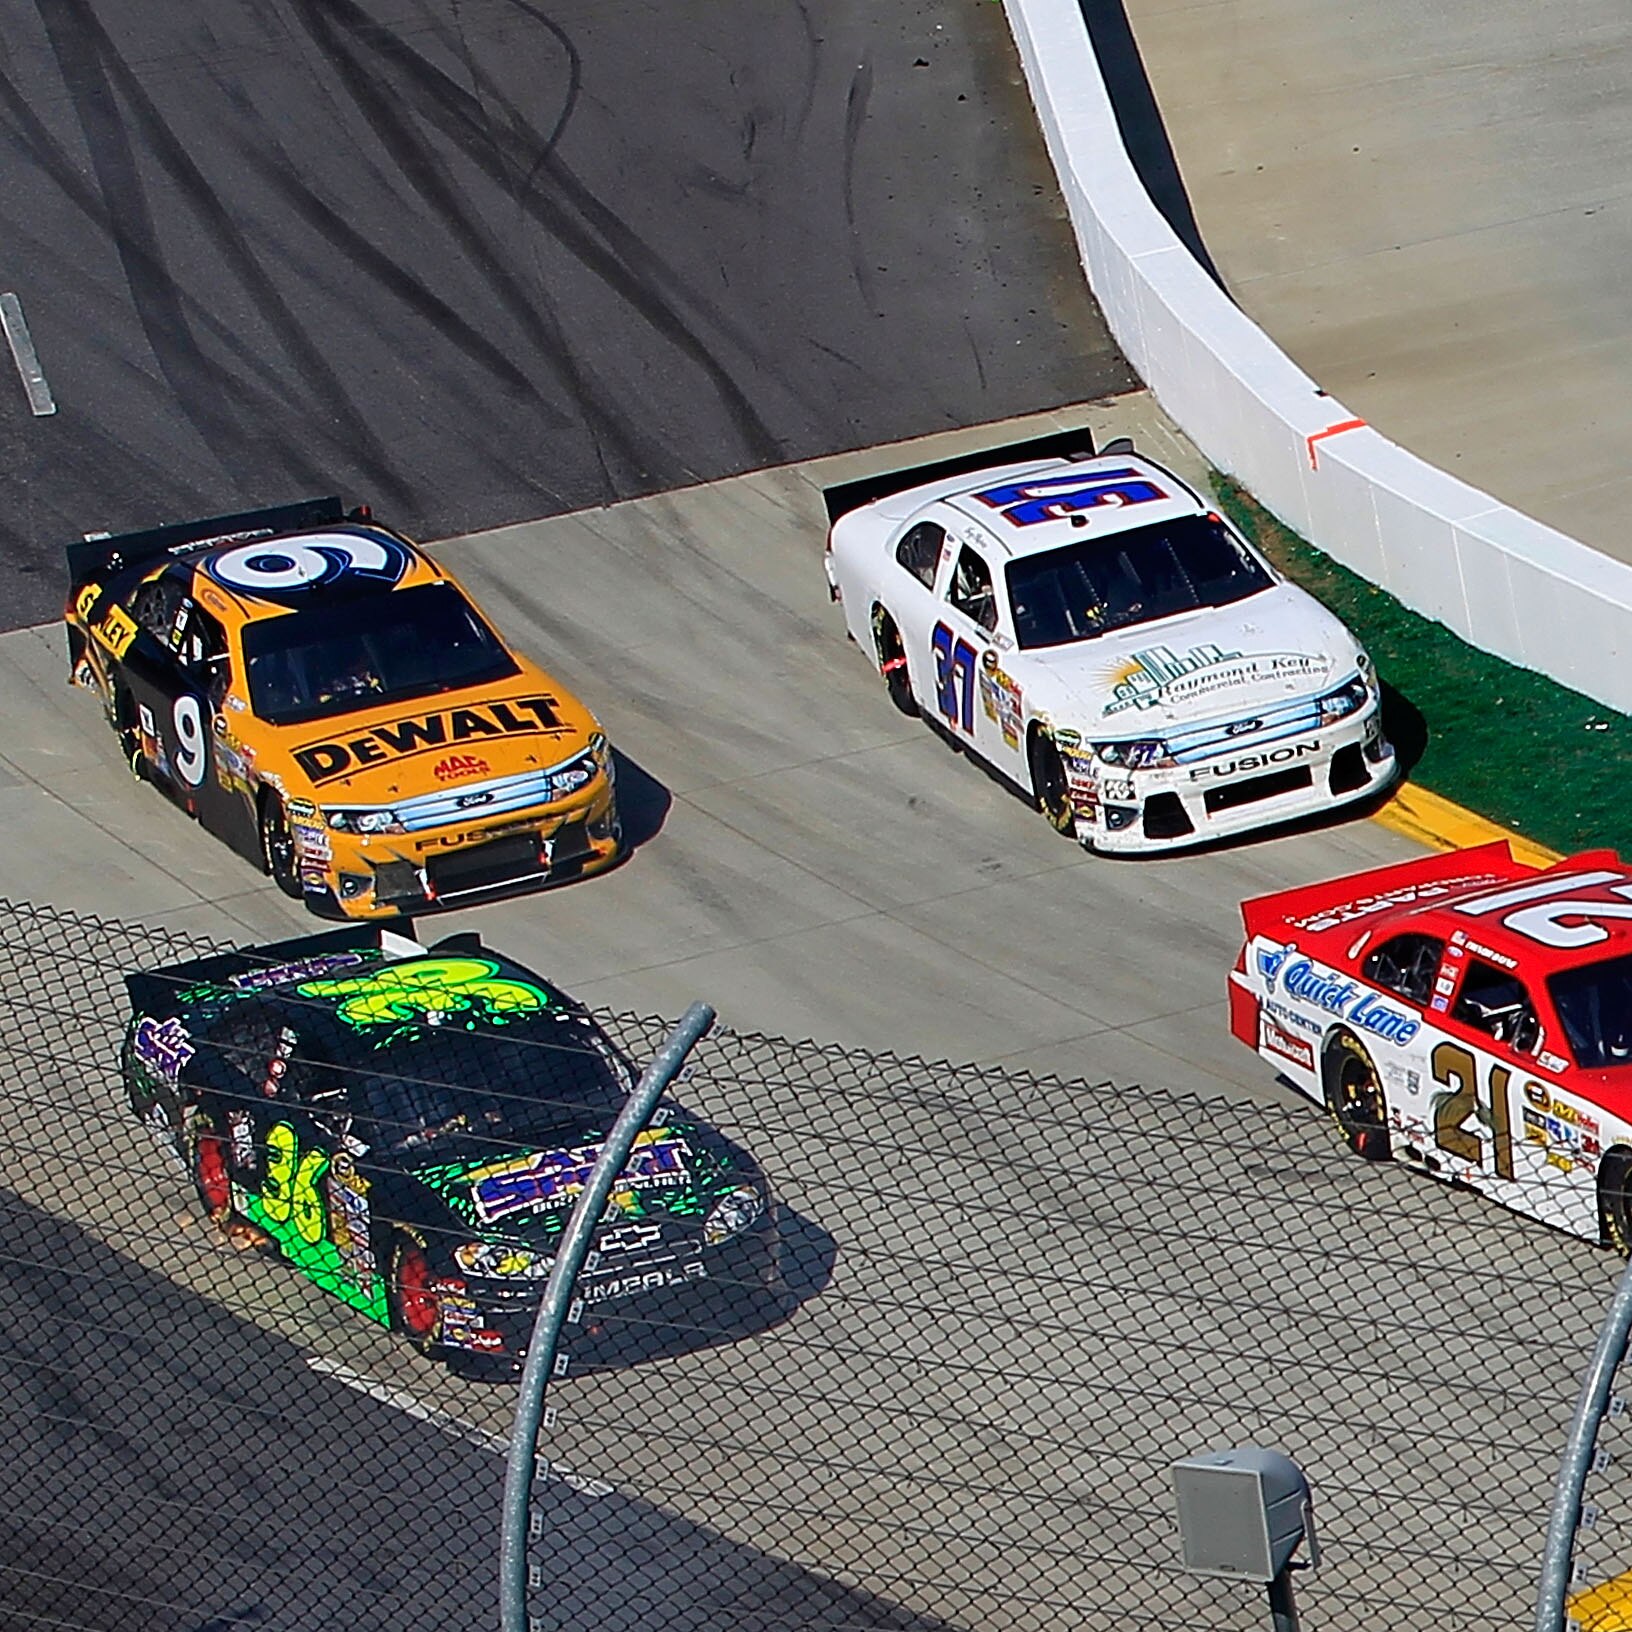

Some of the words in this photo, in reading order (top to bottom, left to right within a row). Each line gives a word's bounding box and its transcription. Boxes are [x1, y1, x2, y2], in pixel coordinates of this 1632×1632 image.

[932, 619, 978, 737] 37
[1157, 662, 1260, 700] Raymond
[1271, 655, 1311, 671] Key
[174, 696, 206, 786] 9
[1189, 740, 1321, 782] FUSION
[1283, 959, 1353, 1017] Quick
[1347, 994, 1421, 1046] Lane
[1431, 1041, 1516, 1183] 21
